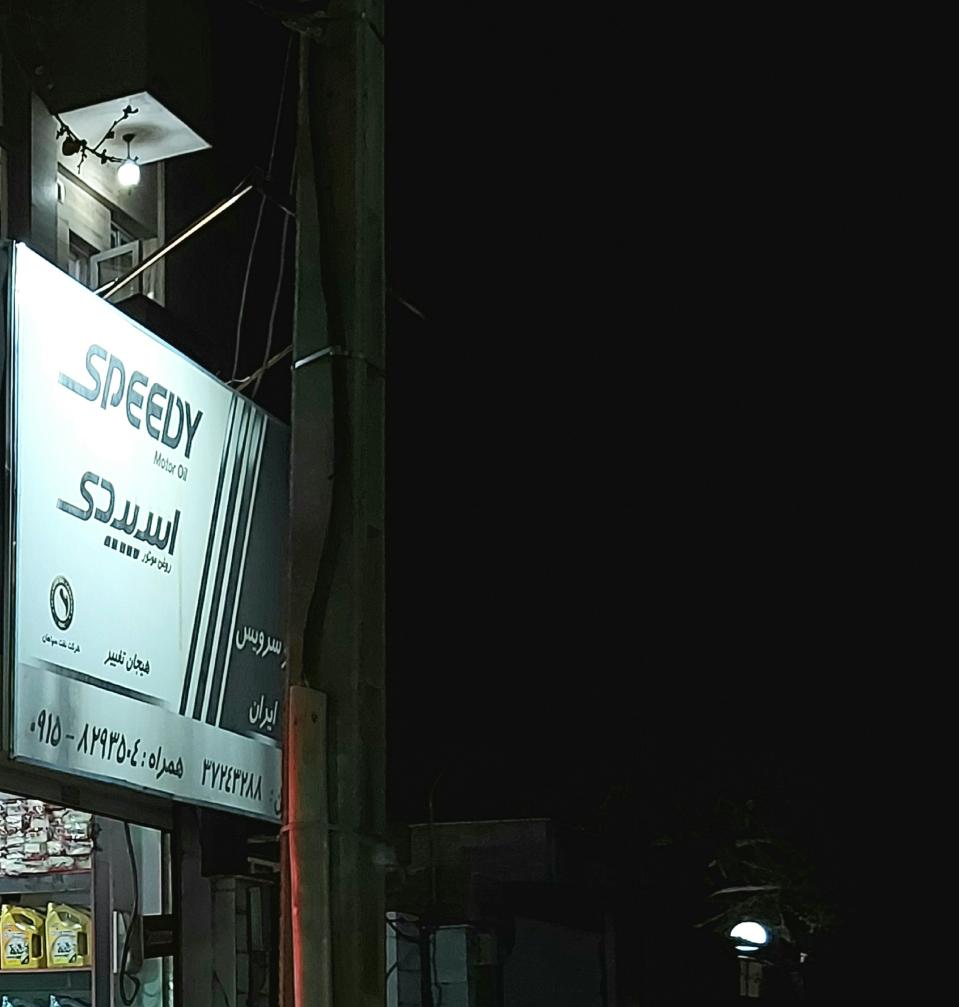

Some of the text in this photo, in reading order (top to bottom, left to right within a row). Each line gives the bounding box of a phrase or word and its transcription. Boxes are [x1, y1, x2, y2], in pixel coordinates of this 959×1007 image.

[57, 343, 204, 460] SPEEDY
[153, 450, 189, 482] Motor Oil
[56, 470, 182, 561] اسپیدی
[235, 625, 282, 658] سرویس
[249, 695, 279, 731] ایران
